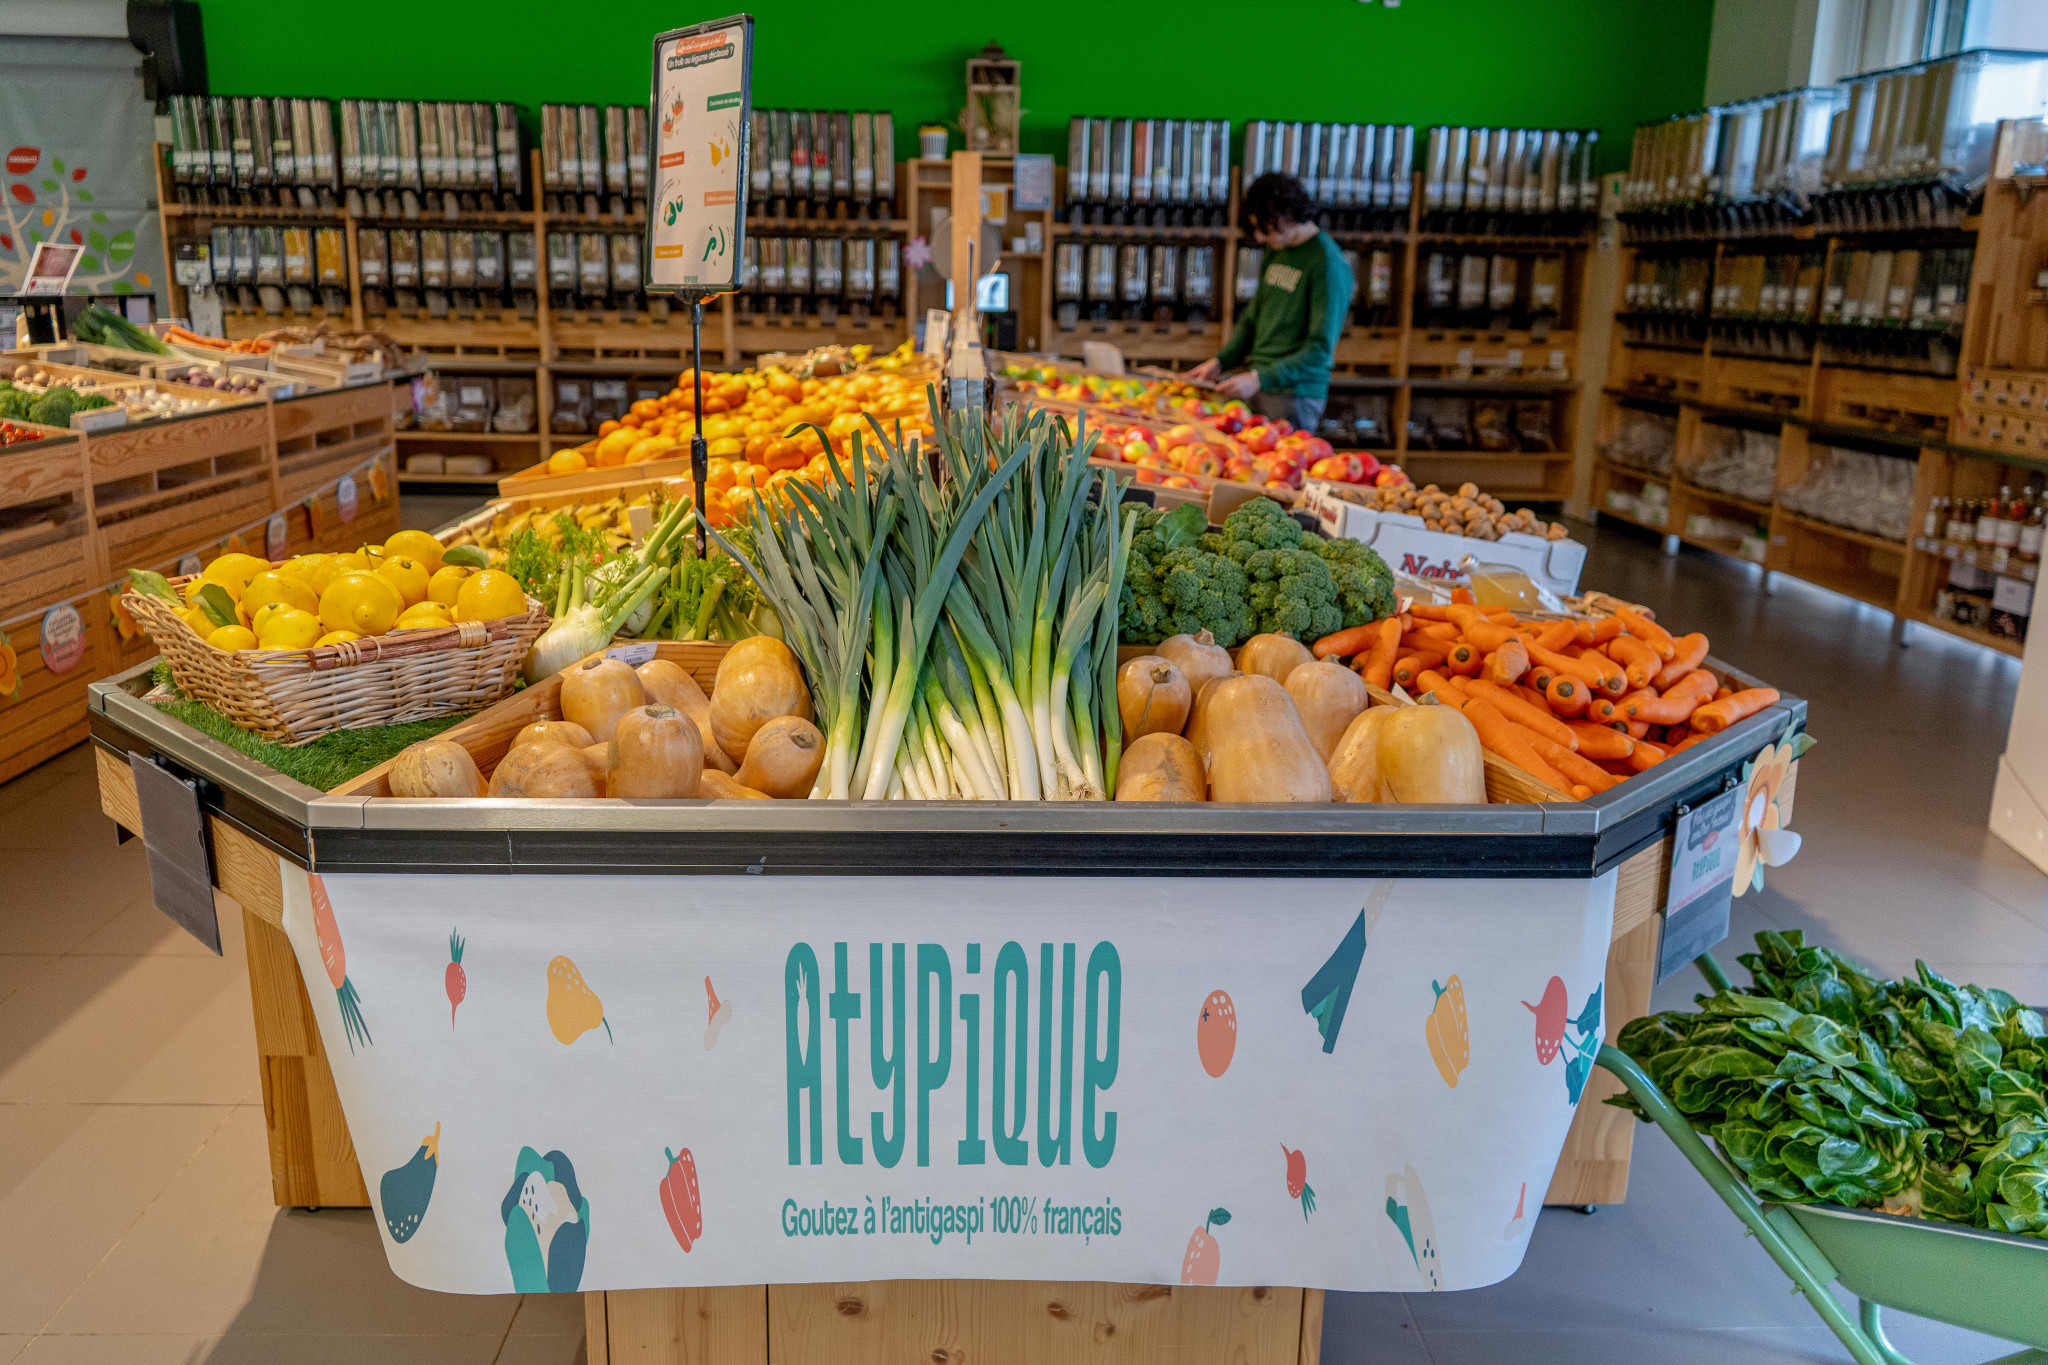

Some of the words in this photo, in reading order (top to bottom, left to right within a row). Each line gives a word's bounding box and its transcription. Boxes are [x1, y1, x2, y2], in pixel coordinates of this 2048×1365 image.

[691, 53, 708, 64] légume
[708, 47, 729, 59] déclassé
[782, 1197, 859, 1238] Goutez
[863, 1195, 876, 1235] à
[881, 1195, 985, 1245] l'antigaspi
[989, 1195, 1037, 1235] 100%
[1043, 1197, 1122, 1246] français
